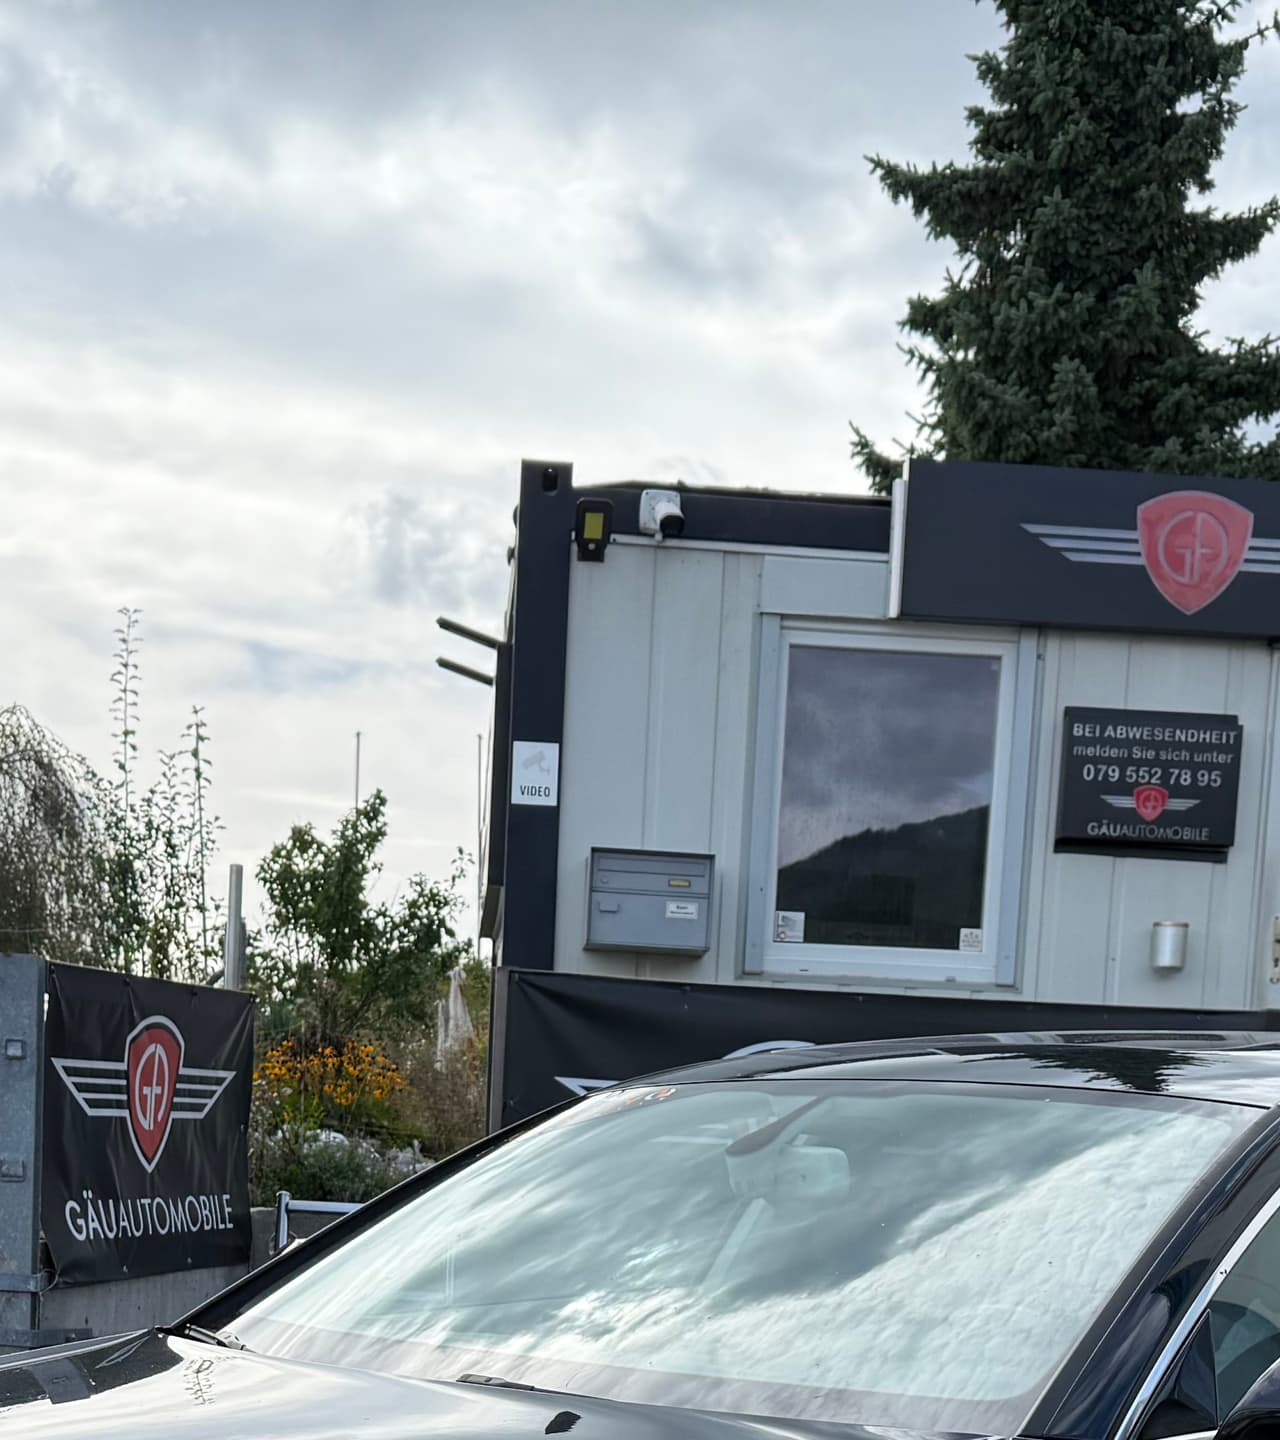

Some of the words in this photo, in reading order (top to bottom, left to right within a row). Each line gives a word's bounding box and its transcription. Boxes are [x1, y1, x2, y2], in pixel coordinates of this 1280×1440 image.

[1072, 723, 1100, 737] BEI
[1104, 725, 1238, 744] ABWESENDHEIT
[1073, 744, 1128, 758] melden
[1132, 746, 1155, 760] Sie
[1159, 747, 1189, 762] sich
[1194, 752, 1234, 763] unter
[1083, 764, 1120, 782] 079
[1125, 767, 1162, 784] 552
[1169, 768, 1192, 786] 78
[1197, 770, 1222, 787] 95
[520, 785, 550, 798] VIDEO
[1087, 820, 1210, 841] GÄUAUTOMOBILE
[65, 1190, 234, 1241] GÄUAUTOMOBILE
